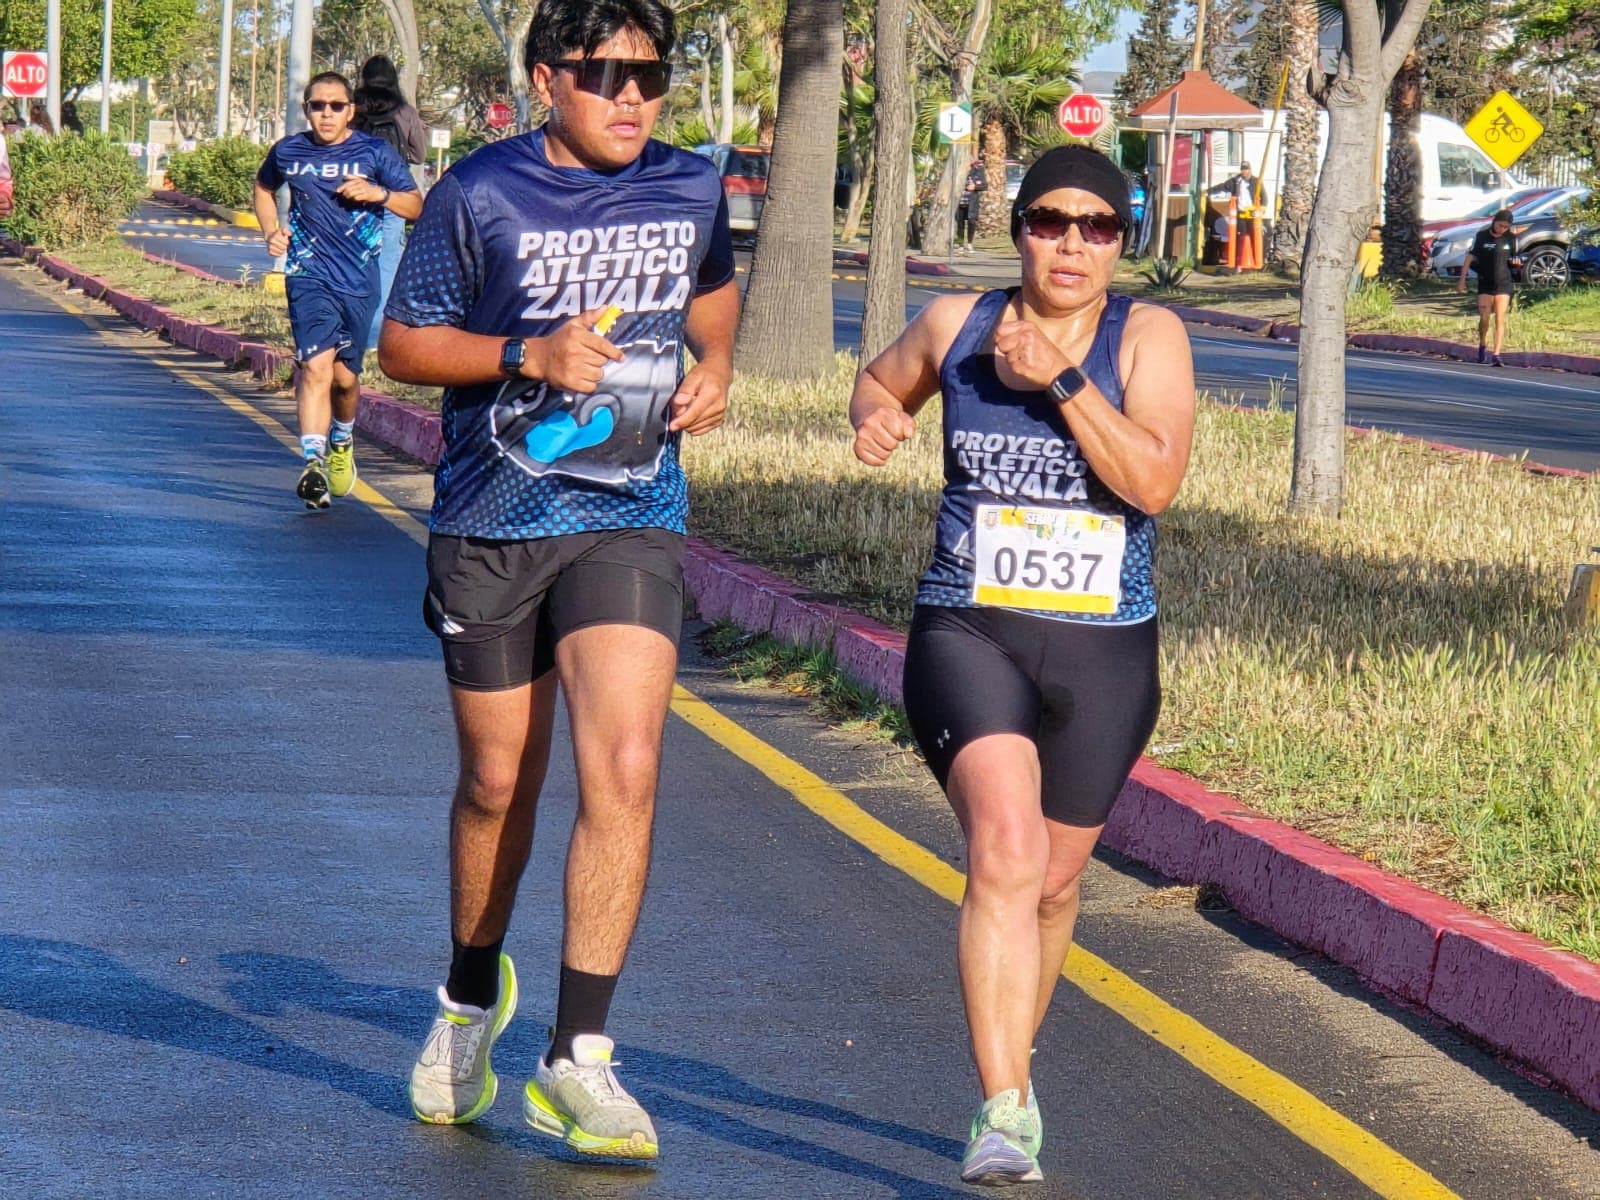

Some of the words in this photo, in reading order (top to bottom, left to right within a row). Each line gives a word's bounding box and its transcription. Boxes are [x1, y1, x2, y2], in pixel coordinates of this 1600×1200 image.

[6, 65, 45, 83] ALTO
[489, 110, 512, 121] ALTO
[949, 113, 963, 133] L
[1063, 106, 1101, 124] ALTO
[286, 162, 368, 178] JABIL
[517, 221, 696, 259] PROYECTO
[519, 247, 688, 287] ATLÉTICO
[520, 275, 691, 320] ZAVALA
[952, 430, 1079, 460] PROYECT
[994, 546, 1104, 592] 0537
